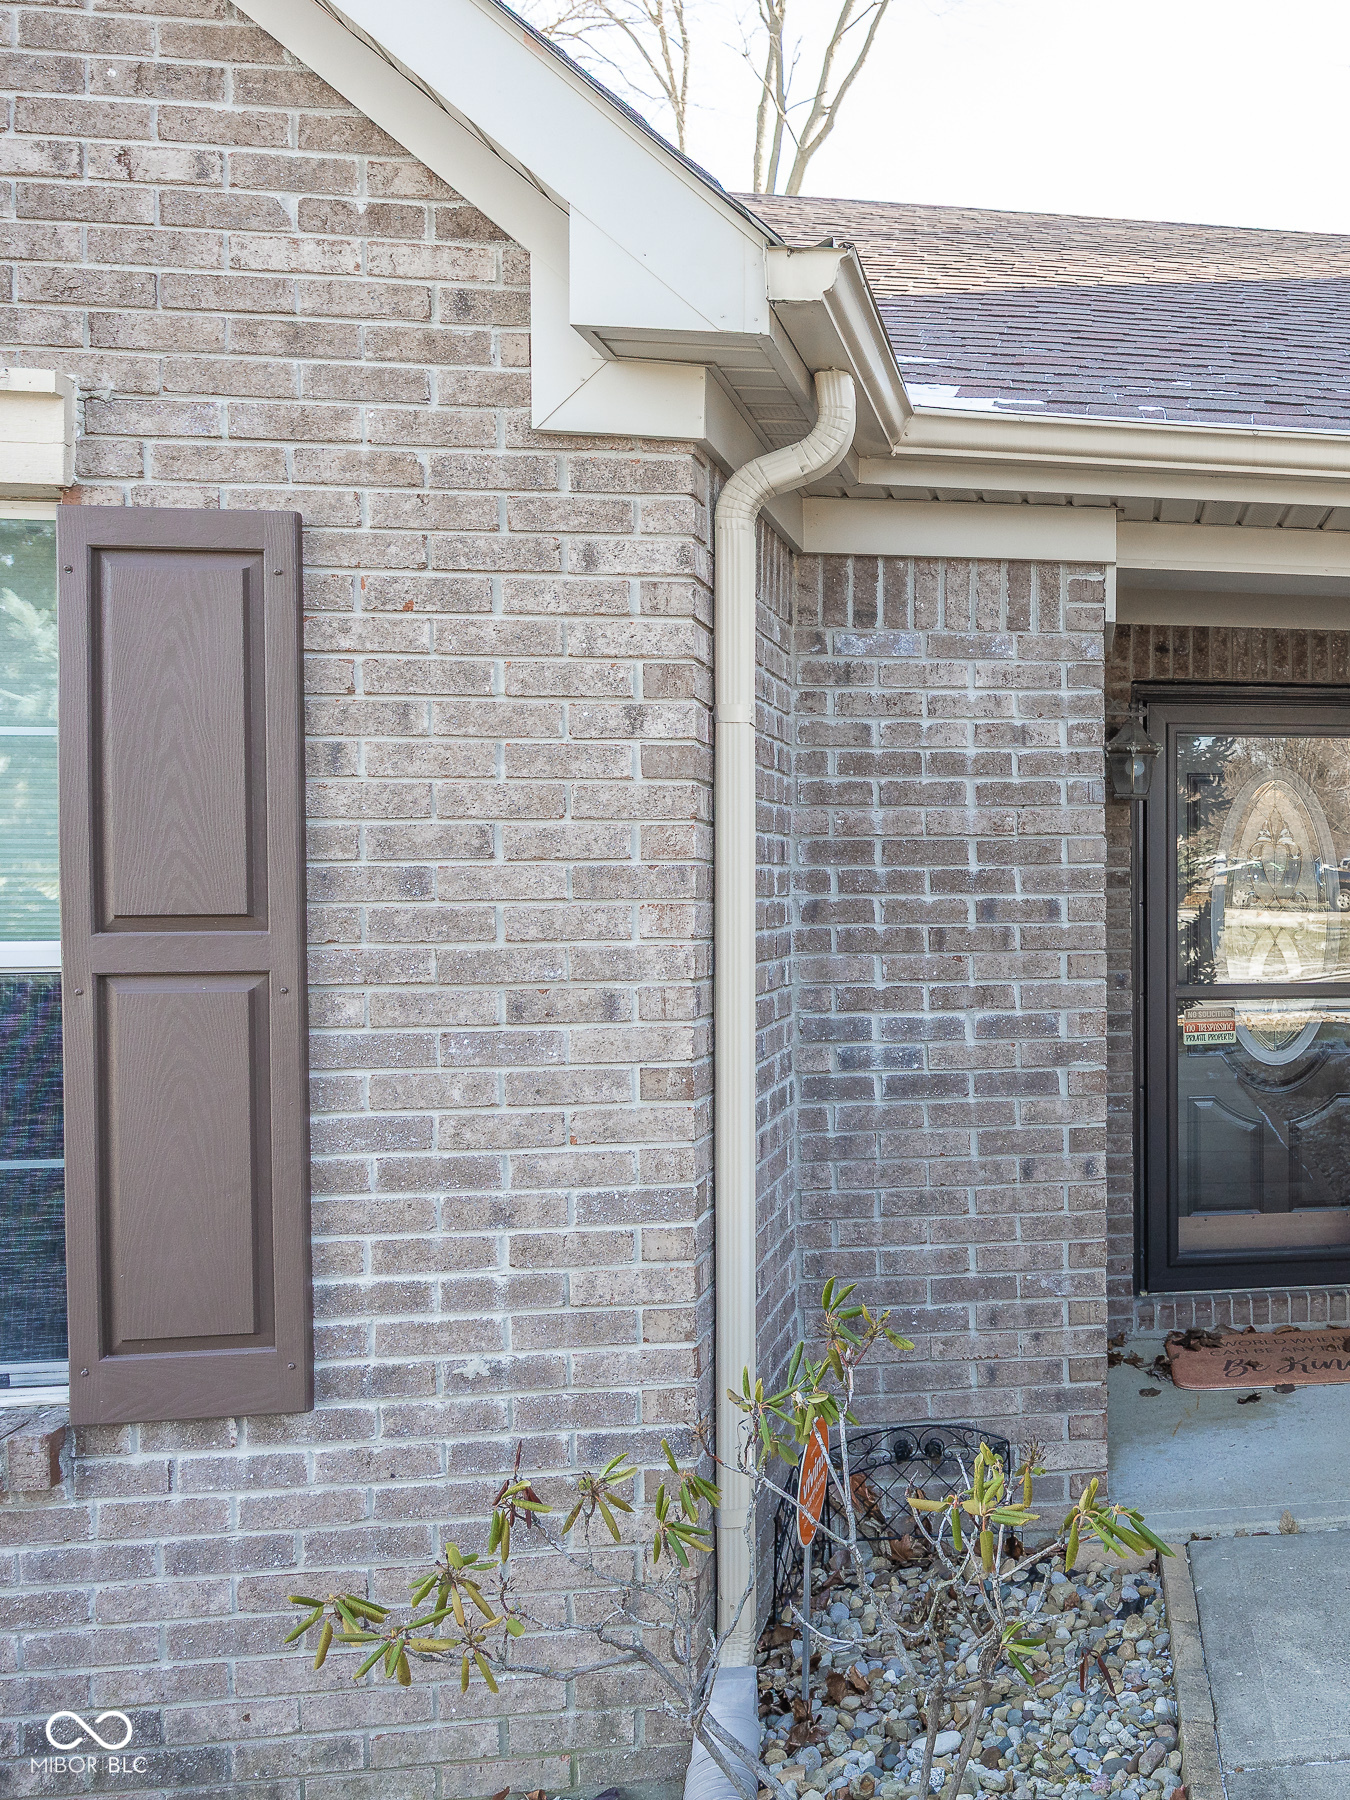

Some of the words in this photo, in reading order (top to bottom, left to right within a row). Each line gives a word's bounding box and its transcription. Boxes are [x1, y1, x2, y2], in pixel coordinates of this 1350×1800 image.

[1198, 1010, 1232, 1018] SOLICITING
[1186, 1034, 1206, 1042] PRIVATE
[1208, 1033, 1234, 1041] PROPERTY
[1220, 1338, 1287, 1348] WORLD
[1209, 1348, 1249, 1357] CAN
